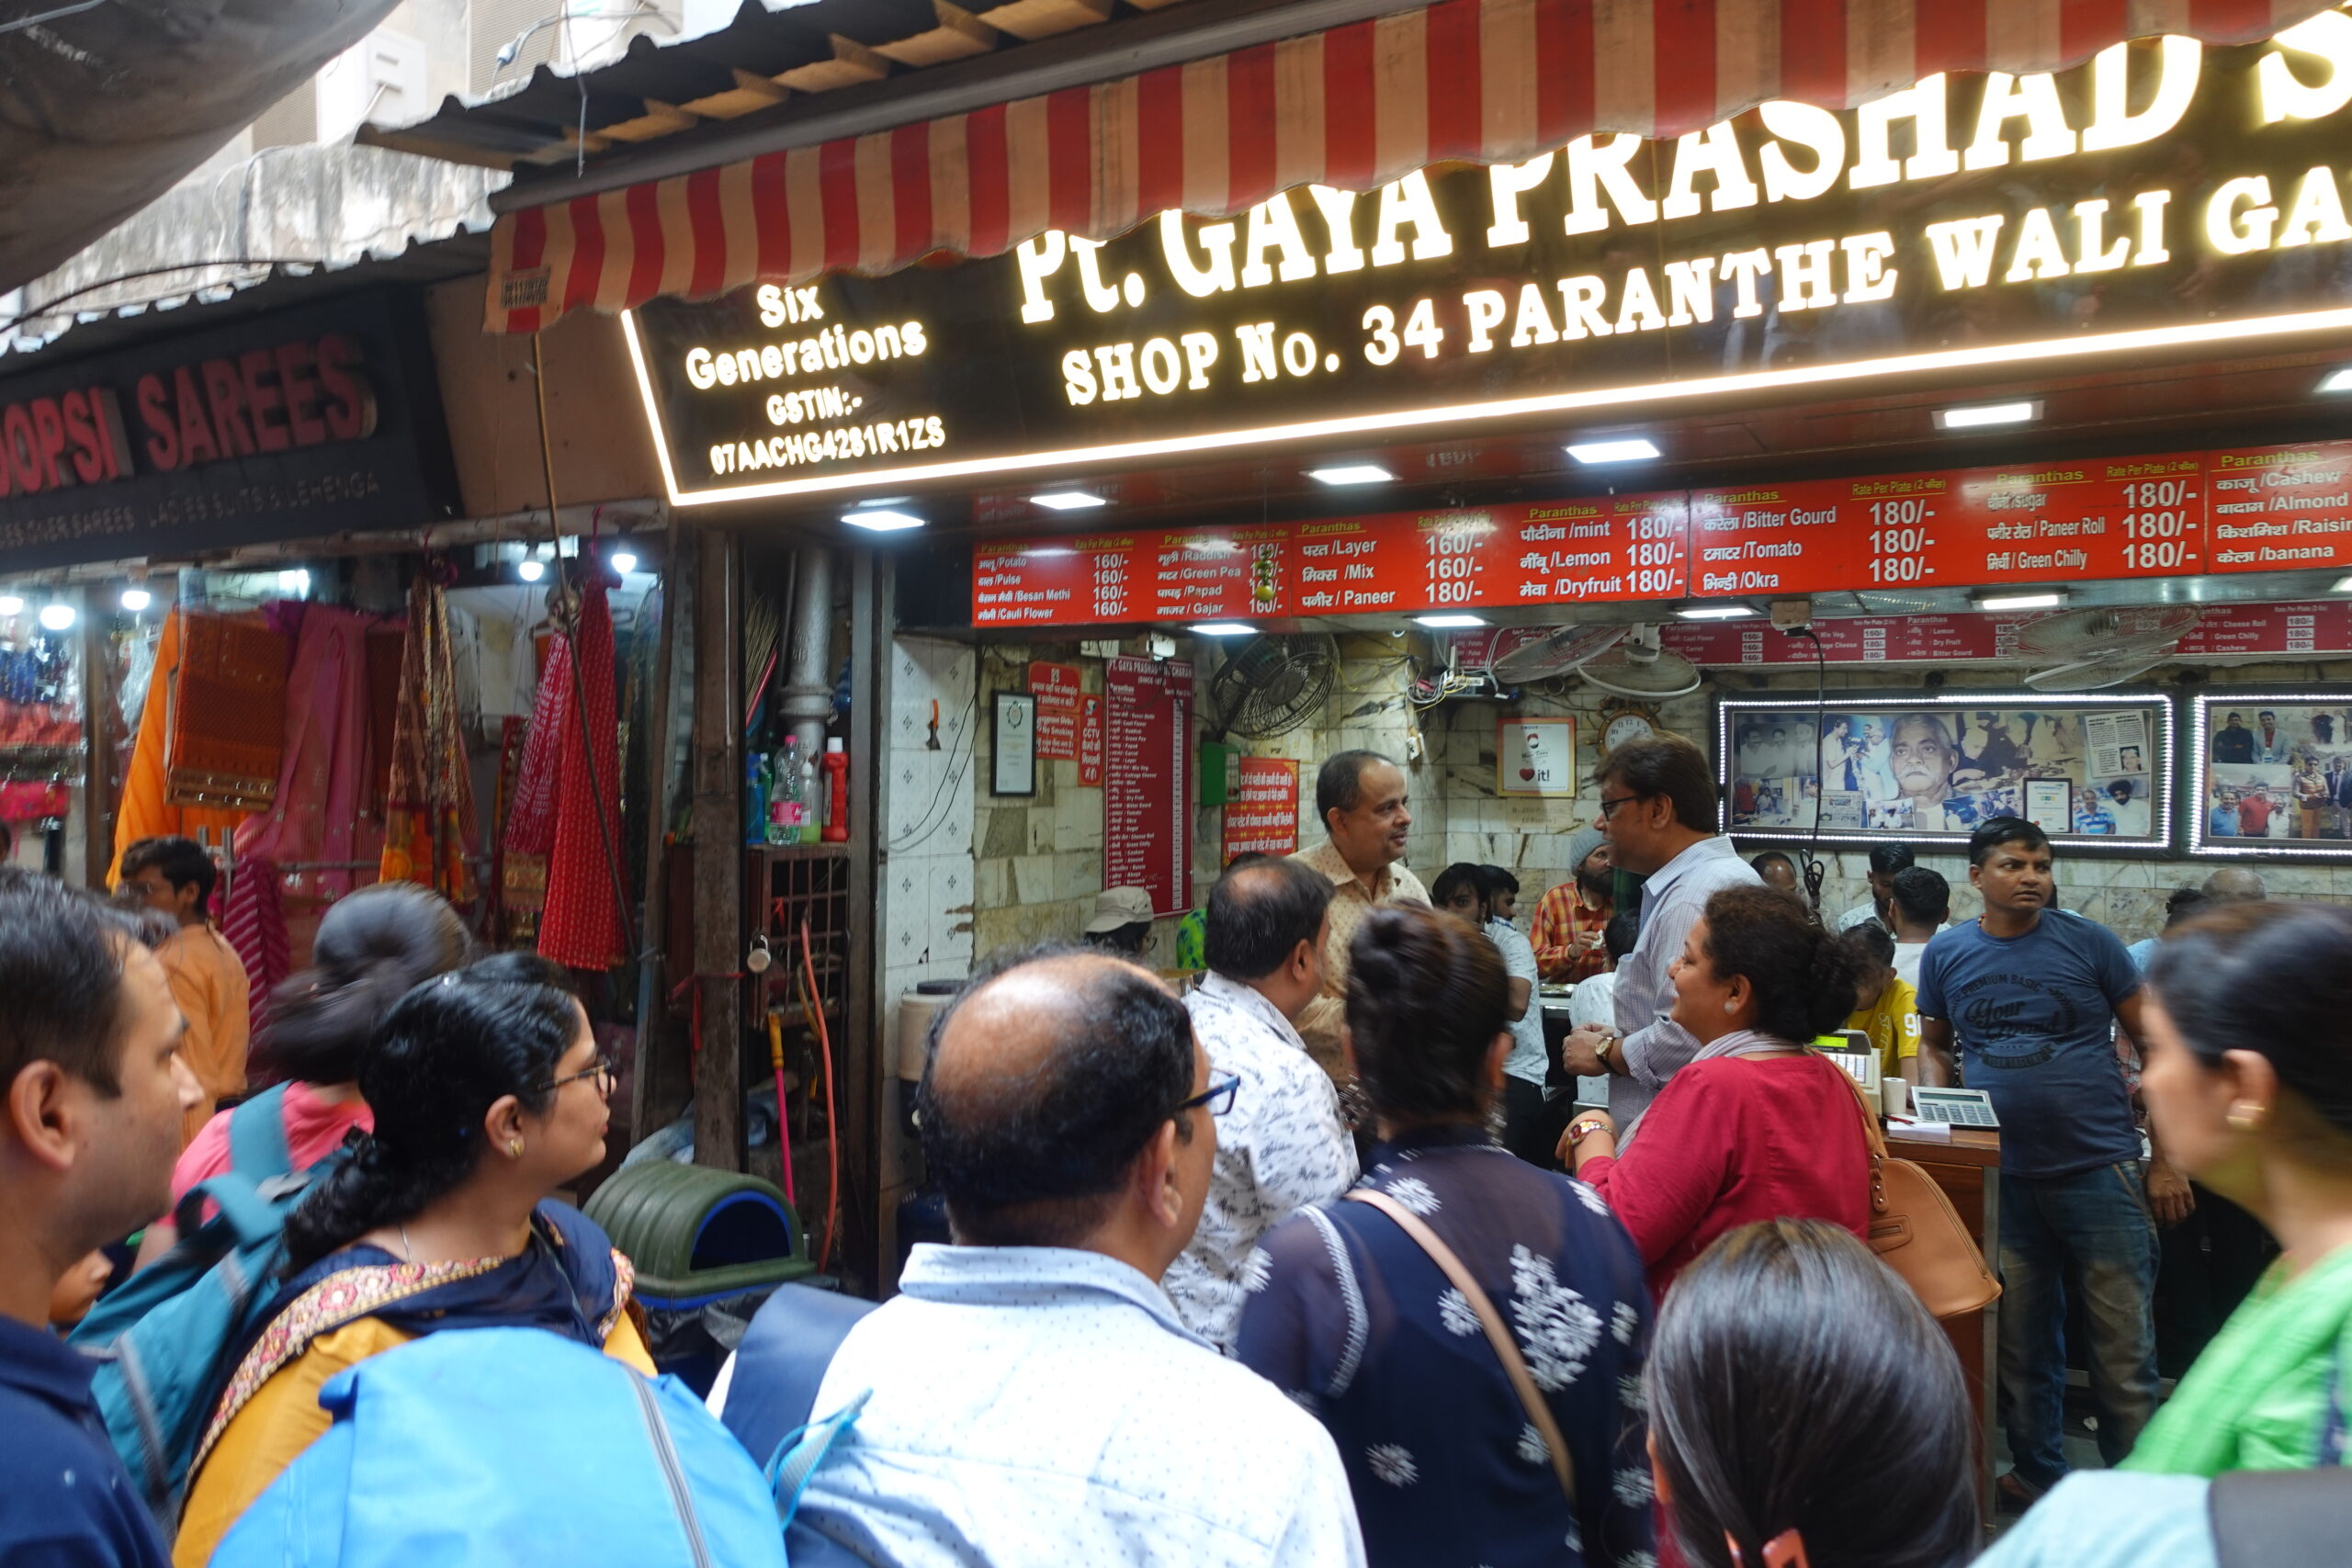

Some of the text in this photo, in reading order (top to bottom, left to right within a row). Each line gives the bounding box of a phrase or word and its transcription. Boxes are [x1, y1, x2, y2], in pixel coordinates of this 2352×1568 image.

[1016, 230, 1145, 323] Pt.
[1160, 169, 1453, 297] GAYA
[1487, 34, 2202, 248] PRASHAD
[757, 284, 824, 328] Six
[1062, 332, 1218, 406] SHOP
[1236, 322, 1340, 383] No.
[1362, 299, 1443, 366] 34
[1463, 231, 1898, 353] PARANTHE
[1926, 190, 2170, 290] WALI
[686, 321, 926, 390] Generations
[137, 334, 365, 472] SAREES
[766, 386, 863, 426] GSTIN:-
[710, 416, 945, 475] 07AACHG4281R1ZS
[2222, 450, 2319, 468] Paranthas
[1996, 469, 2084, 485] Paranthas
[2106, 465, 2126, 478] Rate
[2127, 463, 2143, 476] Per
[2143, 462, 2165, 475] Plate
[2260, 469, 2341, 488] /Cashew
[1704, 491, 1779, 504] Paranthas
[1852, 483, 1872, 496] Rate
[1872, 481, 1888, 494] Per
[1890, 480, 1912, 493] Plate
[2121, 479, 2197, 508] 180/-
[2268, 491, 2348, 511] /Almond
[1529, 506, 1598, 519] Paranthas
[1742, 511, 1786, 530] /Bitter
[1790, 506, 1837, 525] Gourd
[1869, 499, 1936, 525] 180/-
[1301, 521, 1361, 534] Paranthas
[1569, 521, 1611, 539] /mint
[1626, 515, 1683, 540] 180/-
[2040, 519, 2080, 537] Paneer
[2082, 516, 2105, 535] Roll
[2121, 511, 2197, 539] 180/-
[1331, 538, 1377, 558] /Layer
[1425, 534, 1483, 556] 160/-
[1550, 551, 1611, 568] /Lemon
[1626, 541, 1683, 567] 180/-
[1702, 527, 1936, 562] टमाटर /Tomato 180/-
[2018, 551, 2052, 569] Green
[2053, 548, 2087, 570] Chilly
[2121, 540, 2197, 569] 180/-
[2216, 546, 2335, 564] केला /banana
[1092, 569, 1128, 585] 160/-
[1220, 566, 1241, 578] Pea
[1344, 564, 1374, 580] /Mix
[1425, 557, 1483, 579] 160/-
[1740, 570, 1779, 590] /Okra
[1869, 556, 1936, 582] 180/-
[1046, 589, 1070, 601] Methi
[1092, 585, 1128, 601] 160/-
[1183, 584, 1222, 598] /Papad
[1344, 590, 1396, 605] Paneer
[1425, 581, 1483, 604] 180/-
[1555, 576, 1622, 598] /Dryfruit
[1625, 568, 1683, 592] 180/-
[1023, 608, 1054, 619] Flower
[1092, 601, 1128, 616] 160/-
[1193, 603, 1224, 615] Gajar
[1537, 770, 1550, 782] it!
[1961, 974, 2043, 997] PREMIUM BASIC
